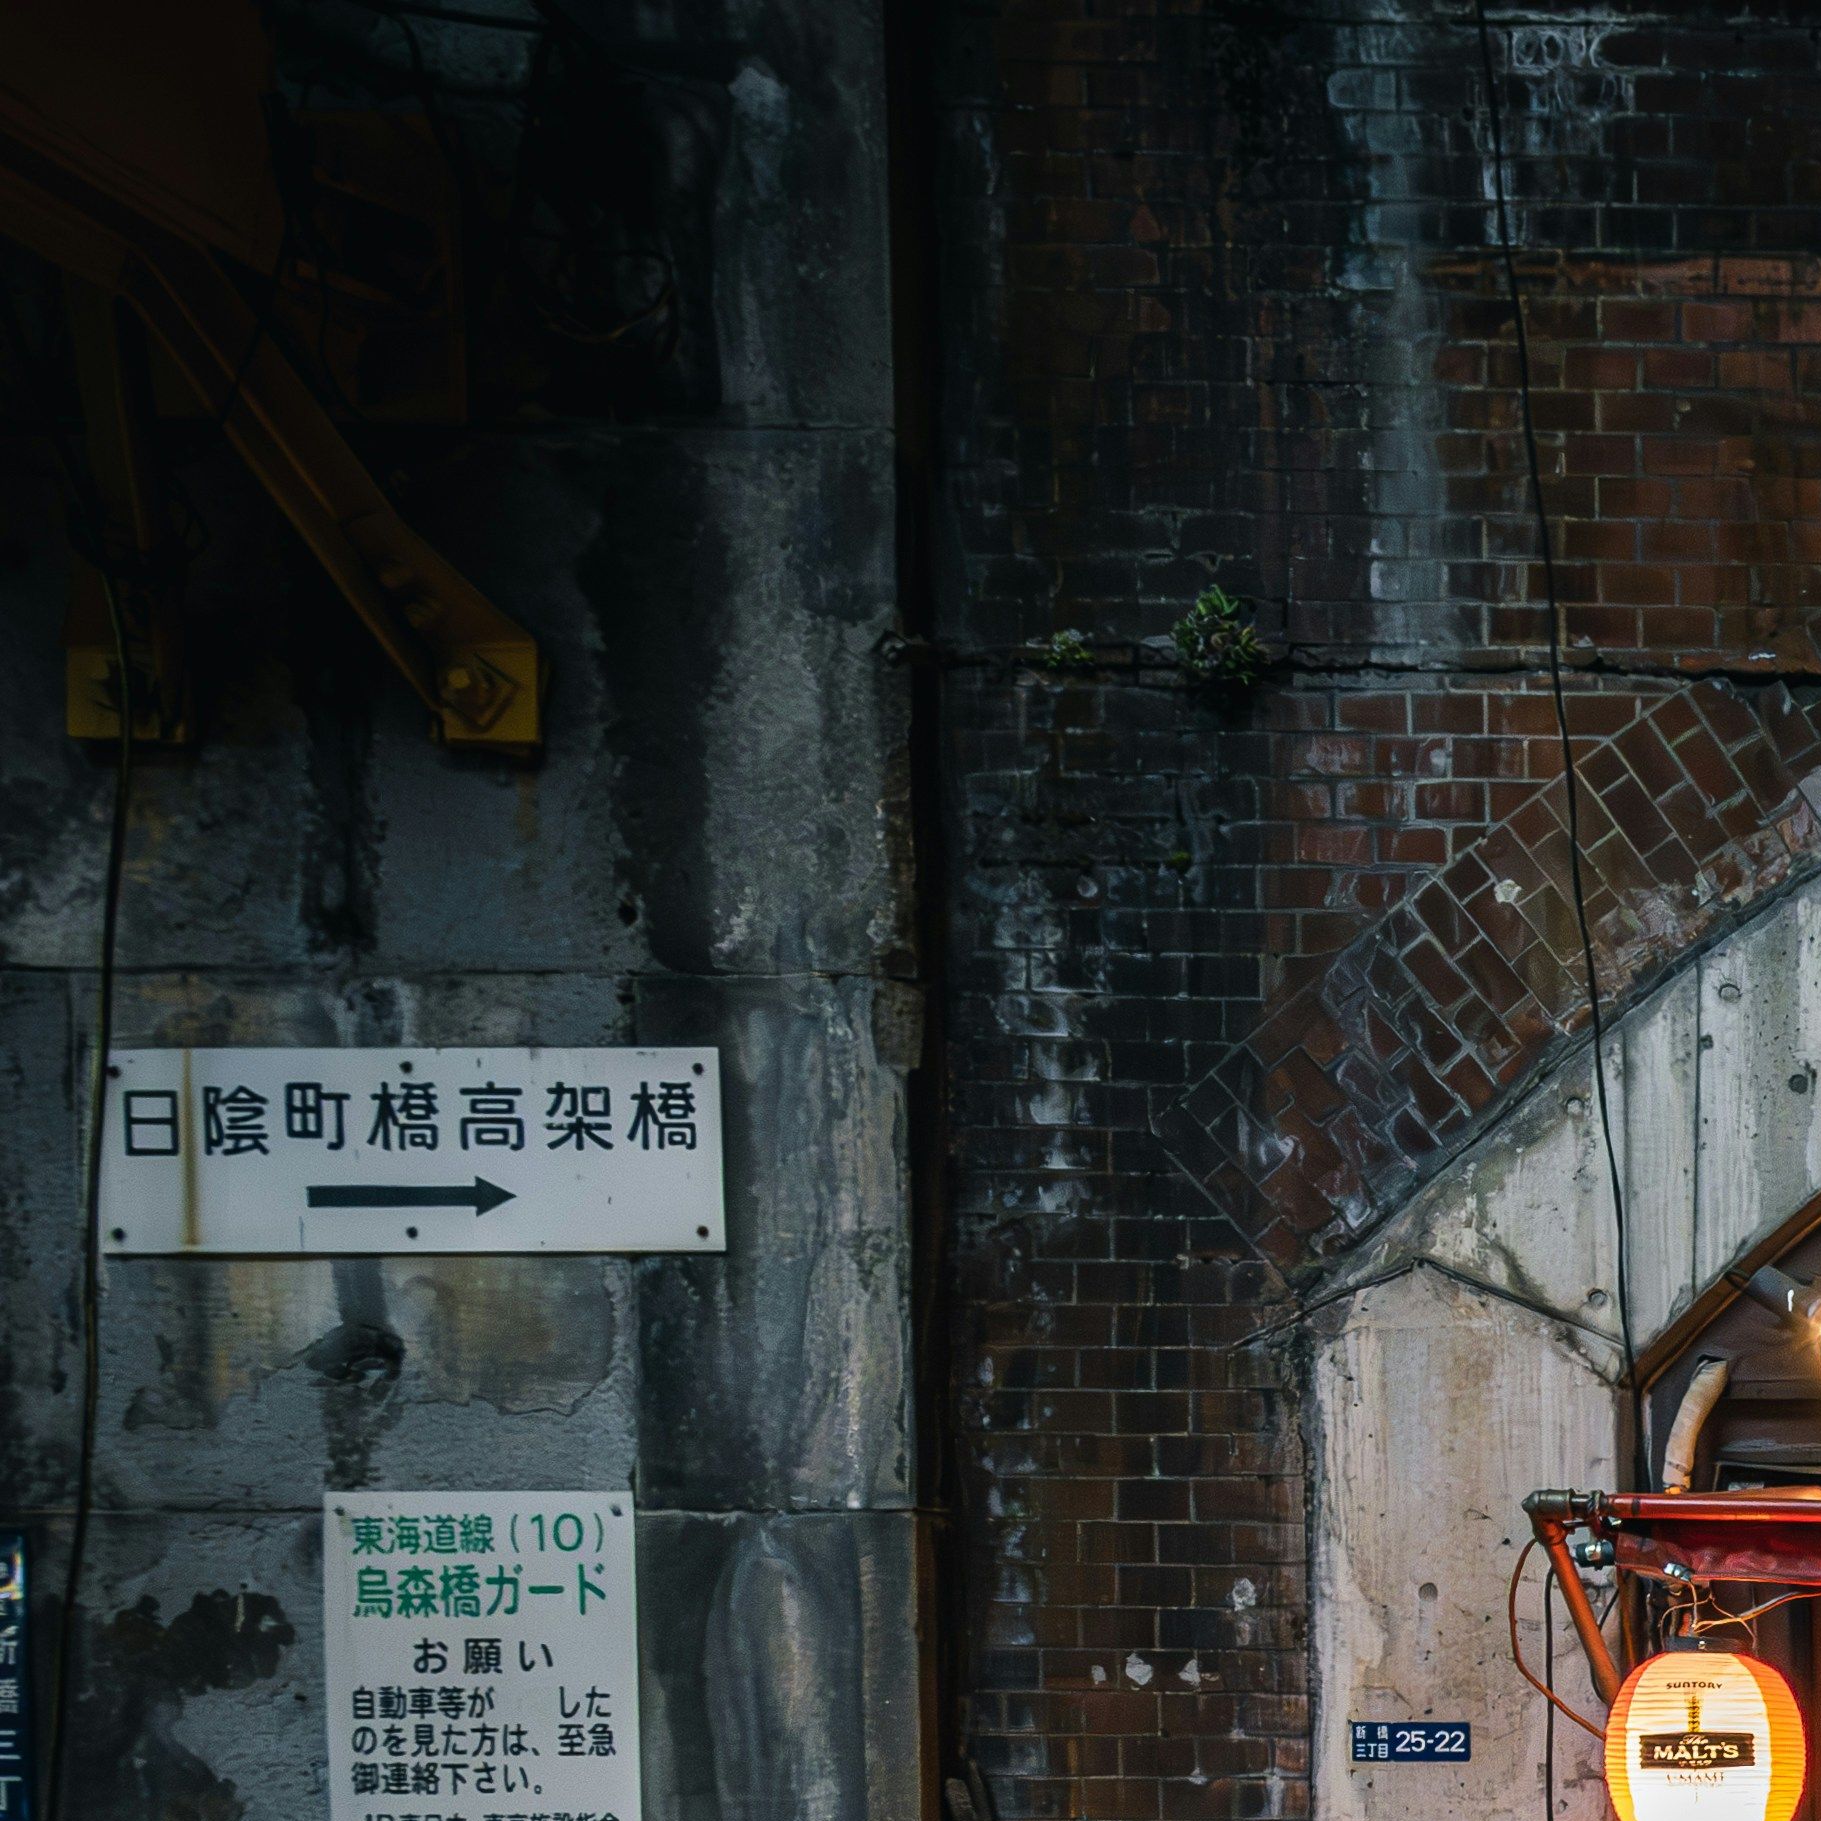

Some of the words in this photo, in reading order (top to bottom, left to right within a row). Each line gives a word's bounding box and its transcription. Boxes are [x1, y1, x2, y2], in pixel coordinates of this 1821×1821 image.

[122, 1080, 698, 1156] 日陰町橋高架橋
[412, 1637, 554, 1674] お願い
[1665, 1681, 1723, 1690] SUNTORY
[351, 1685, 495, 1720] 自動車等が
[558, 1685, 613, 1719] した
[1355, 1743, 1389, 1759] 三丁目
[1395, 1730, 1466, 1753] 25-22
[1653, 1741, 1740, 1760] MALT'S
